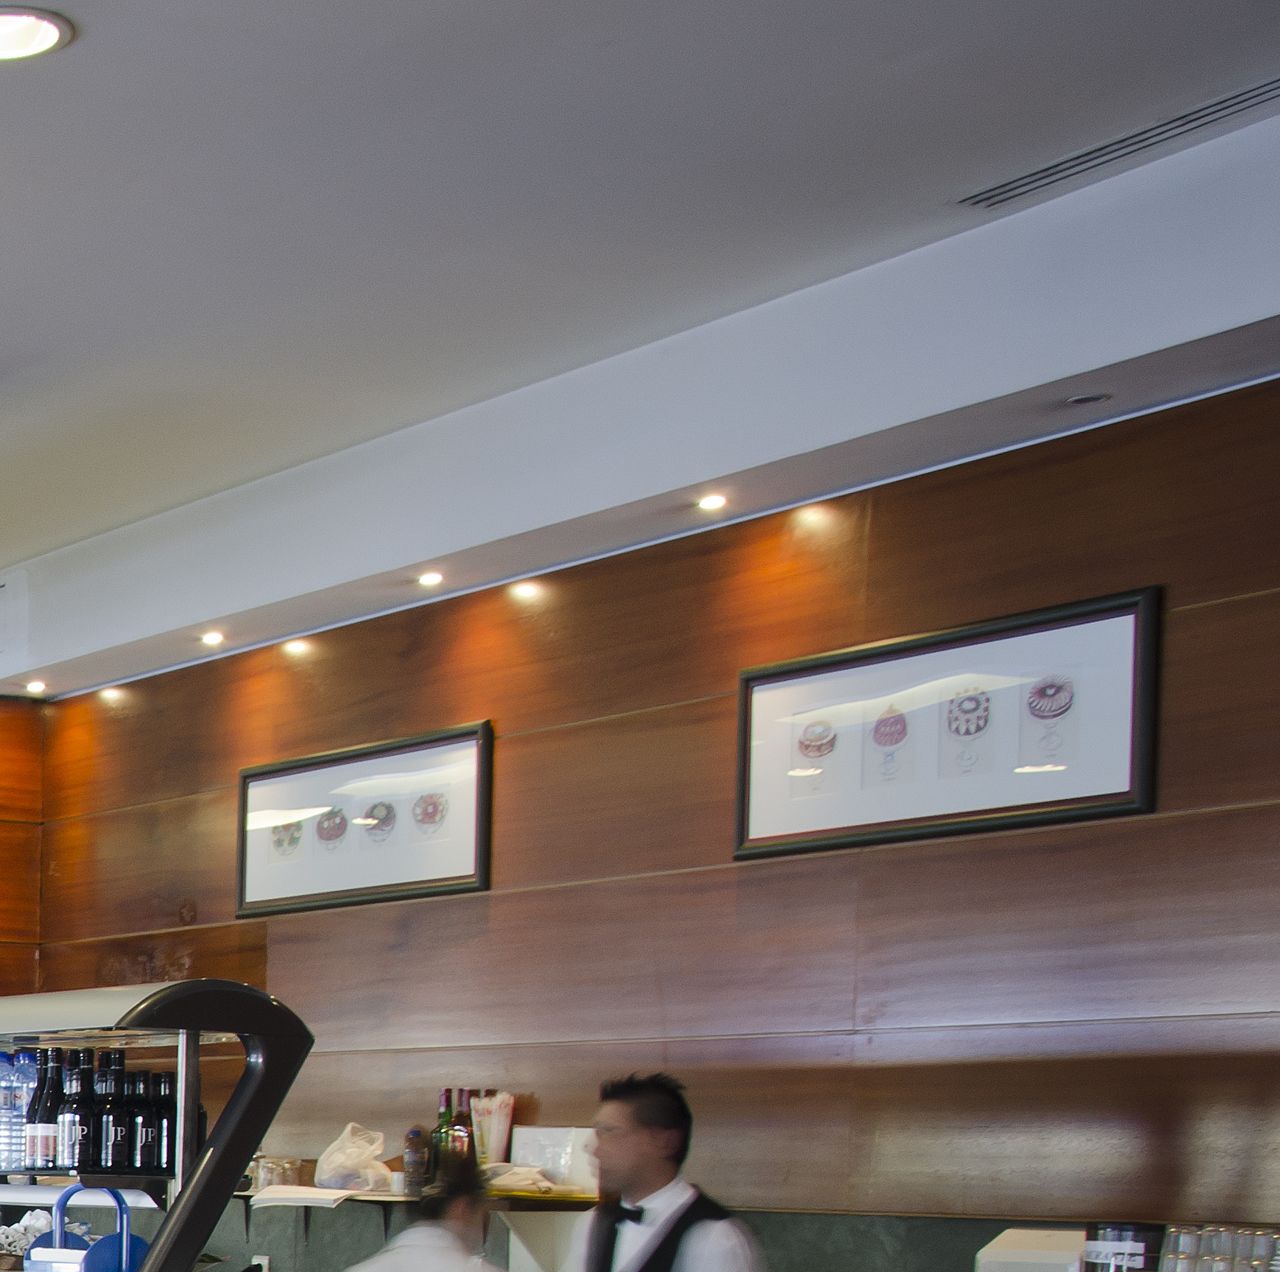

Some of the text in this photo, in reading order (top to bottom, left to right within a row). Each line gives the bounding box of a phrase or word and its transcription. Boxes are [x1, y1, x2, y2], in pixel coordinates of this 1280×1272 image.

[69, 1125, 88, 1144] JP
[108, 1126, 126, 1145] JP
[139, 1127, 156, 1146] JP
